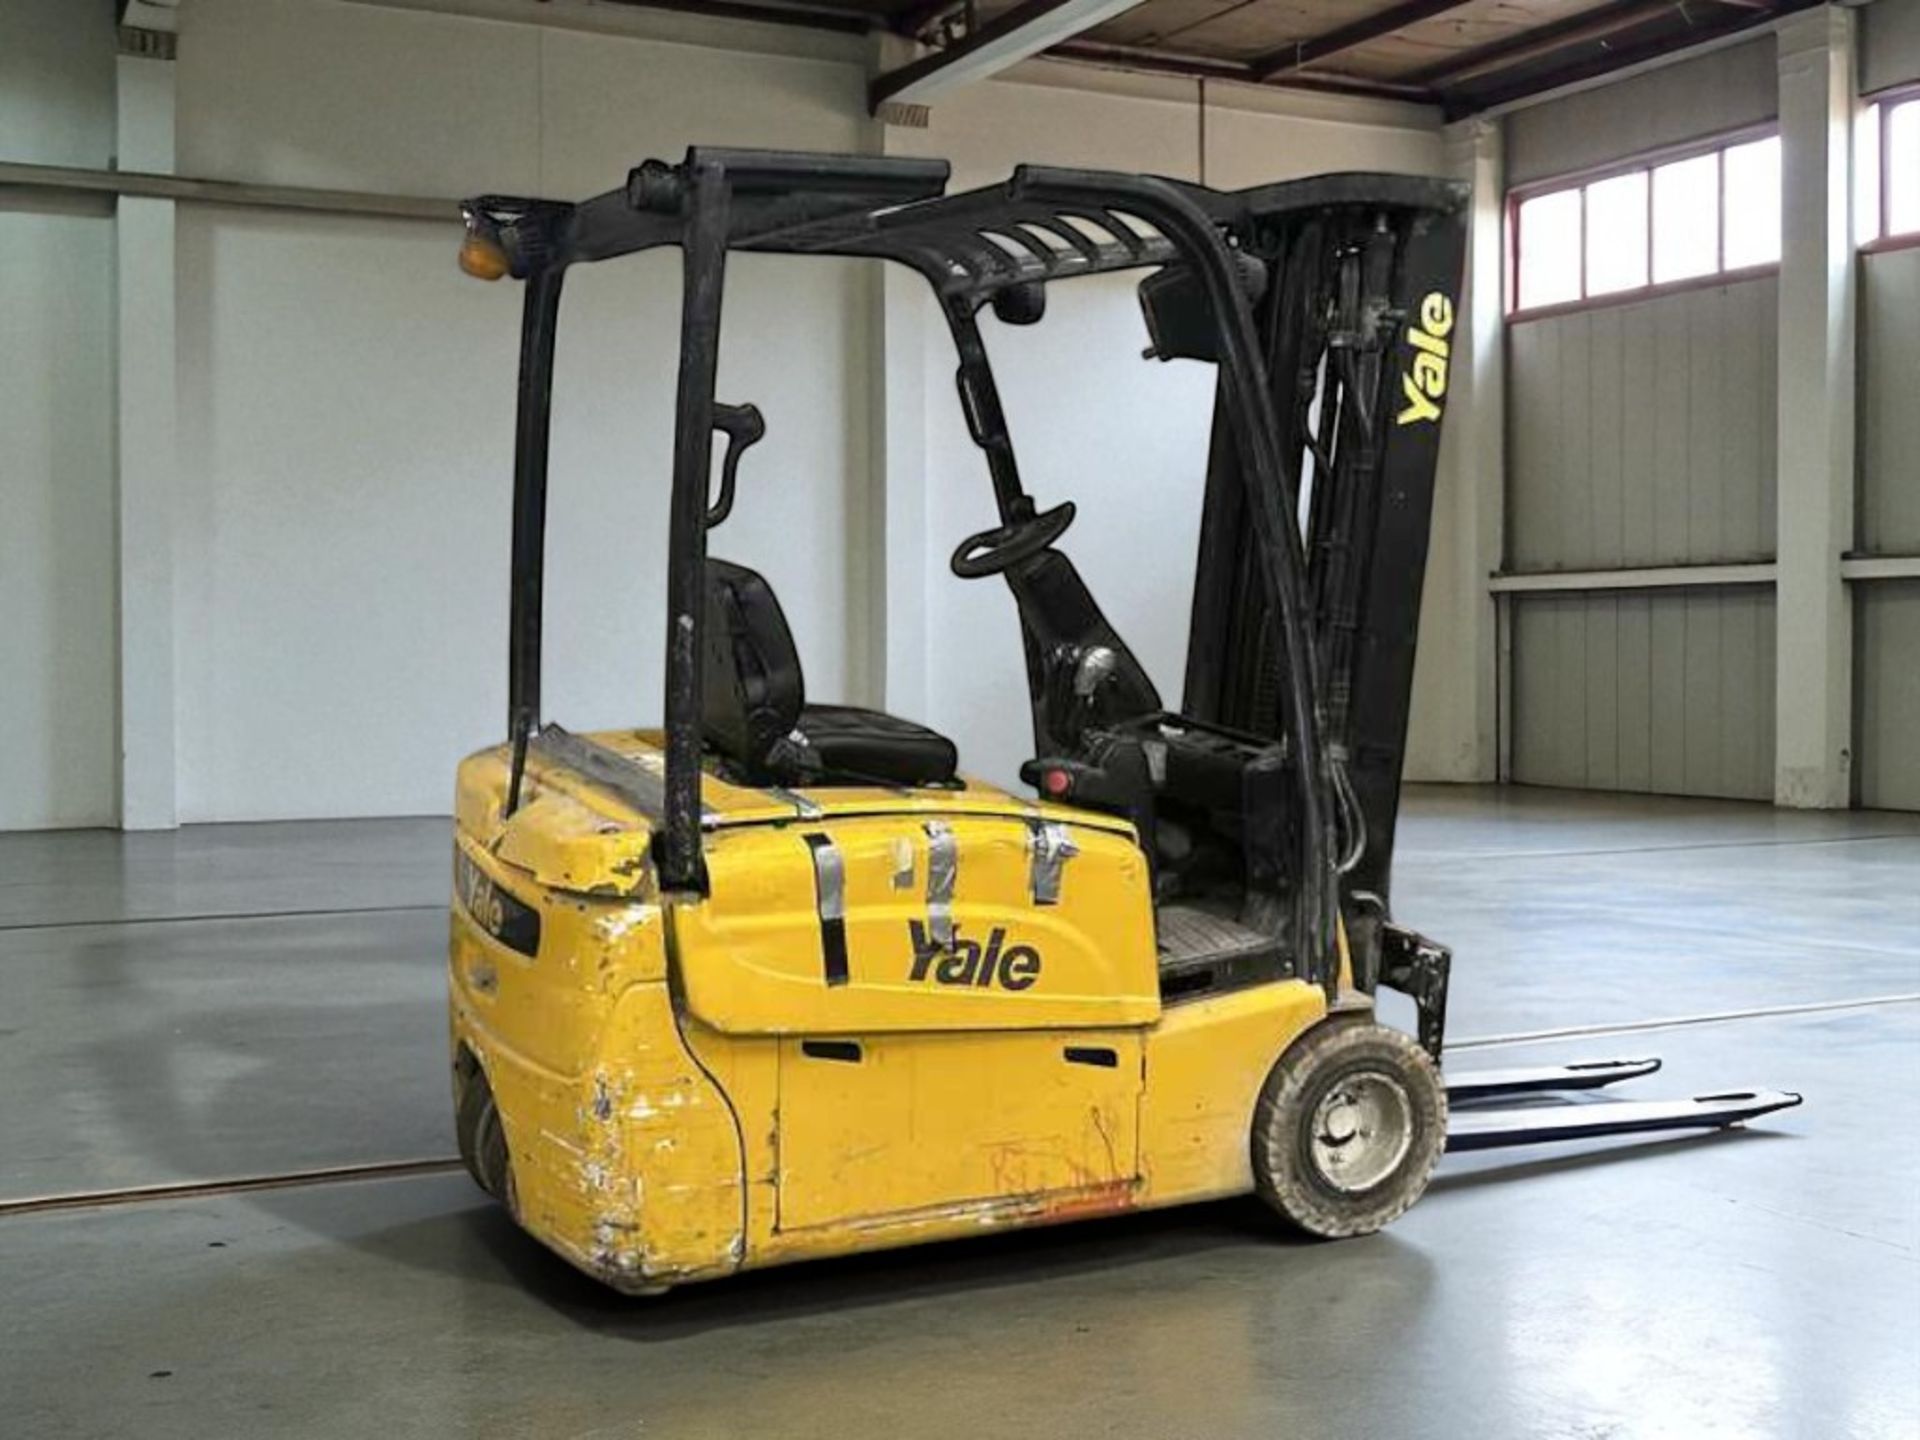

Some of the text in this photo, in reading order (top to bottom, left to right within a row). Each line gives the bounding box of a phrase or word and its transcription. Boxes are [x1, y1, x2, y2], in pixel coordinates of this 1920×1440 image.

[1397, 291, 1453, 425] Yale
[467, 862, 503, 937] Yale
[908, 919, 1041, 991] Yale
